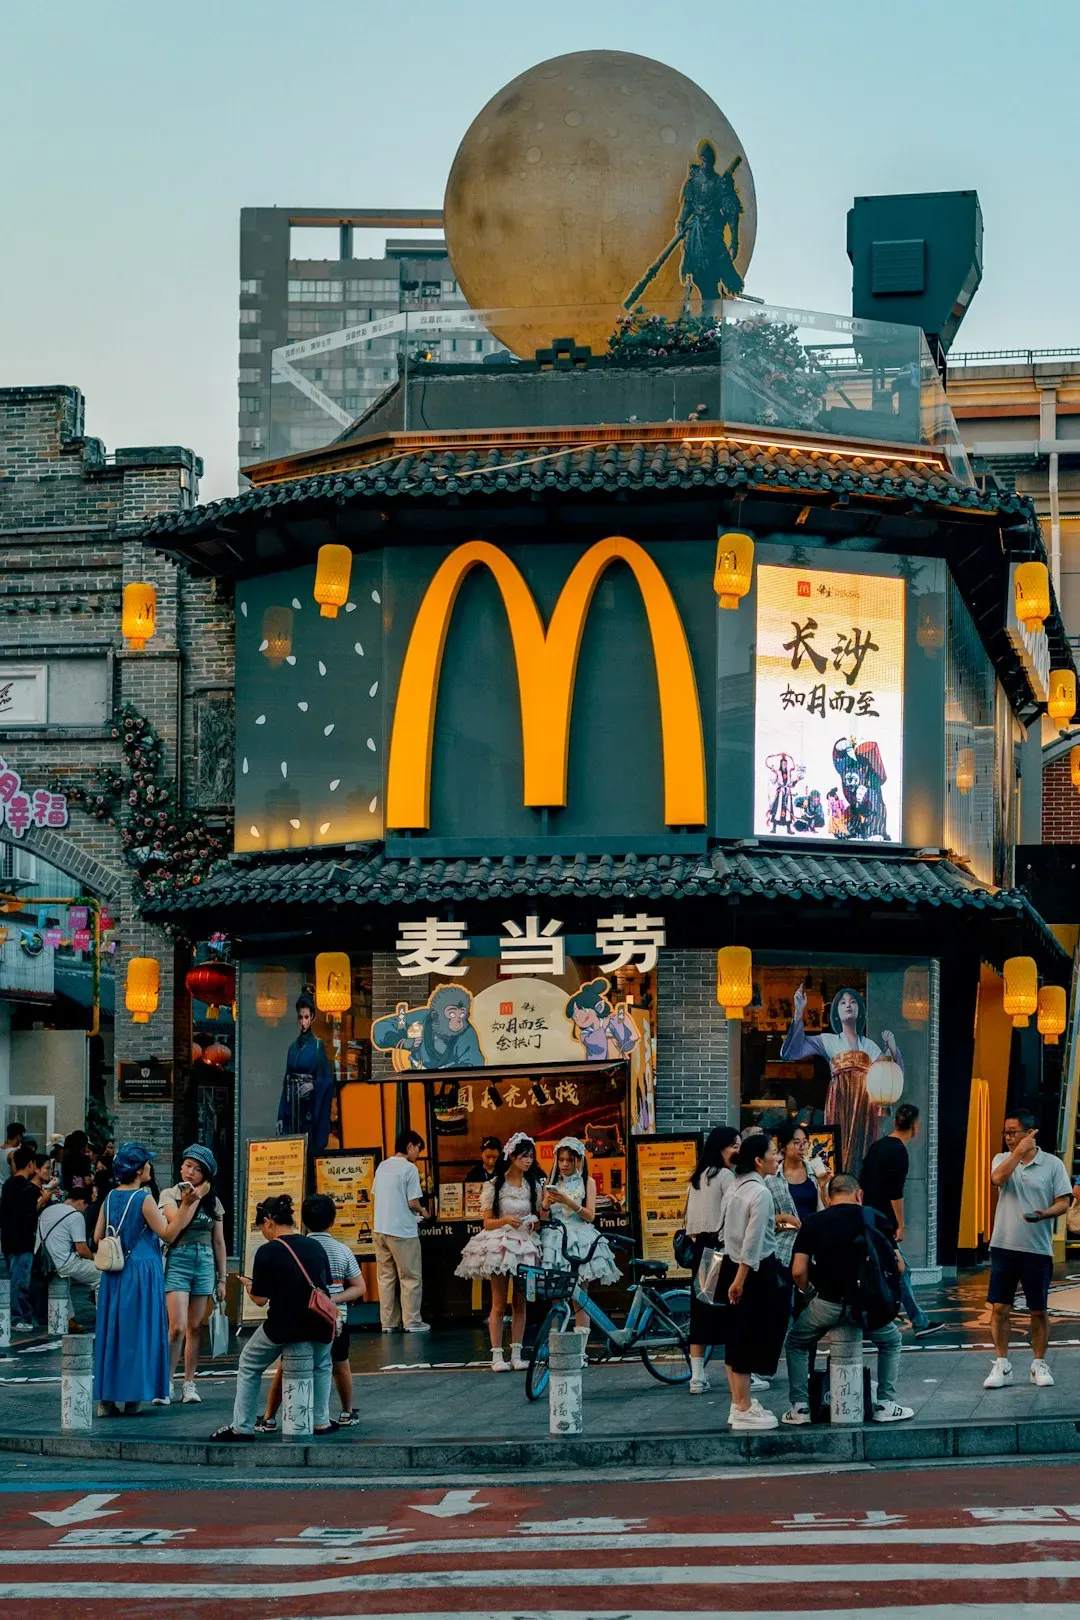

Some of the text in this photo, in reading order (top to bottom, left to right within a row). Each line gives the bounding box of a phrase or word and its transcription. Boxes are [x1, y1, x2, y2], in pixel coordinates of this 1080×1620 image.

[782, 617, 880, 686] 长沙
[779, 683, 880, 718] 如月而至
[396, 913, 667, 976] 麦当劳
[491, 1017, 549, 1034] 如月而至
[445, 1225, 453, 1235] it
